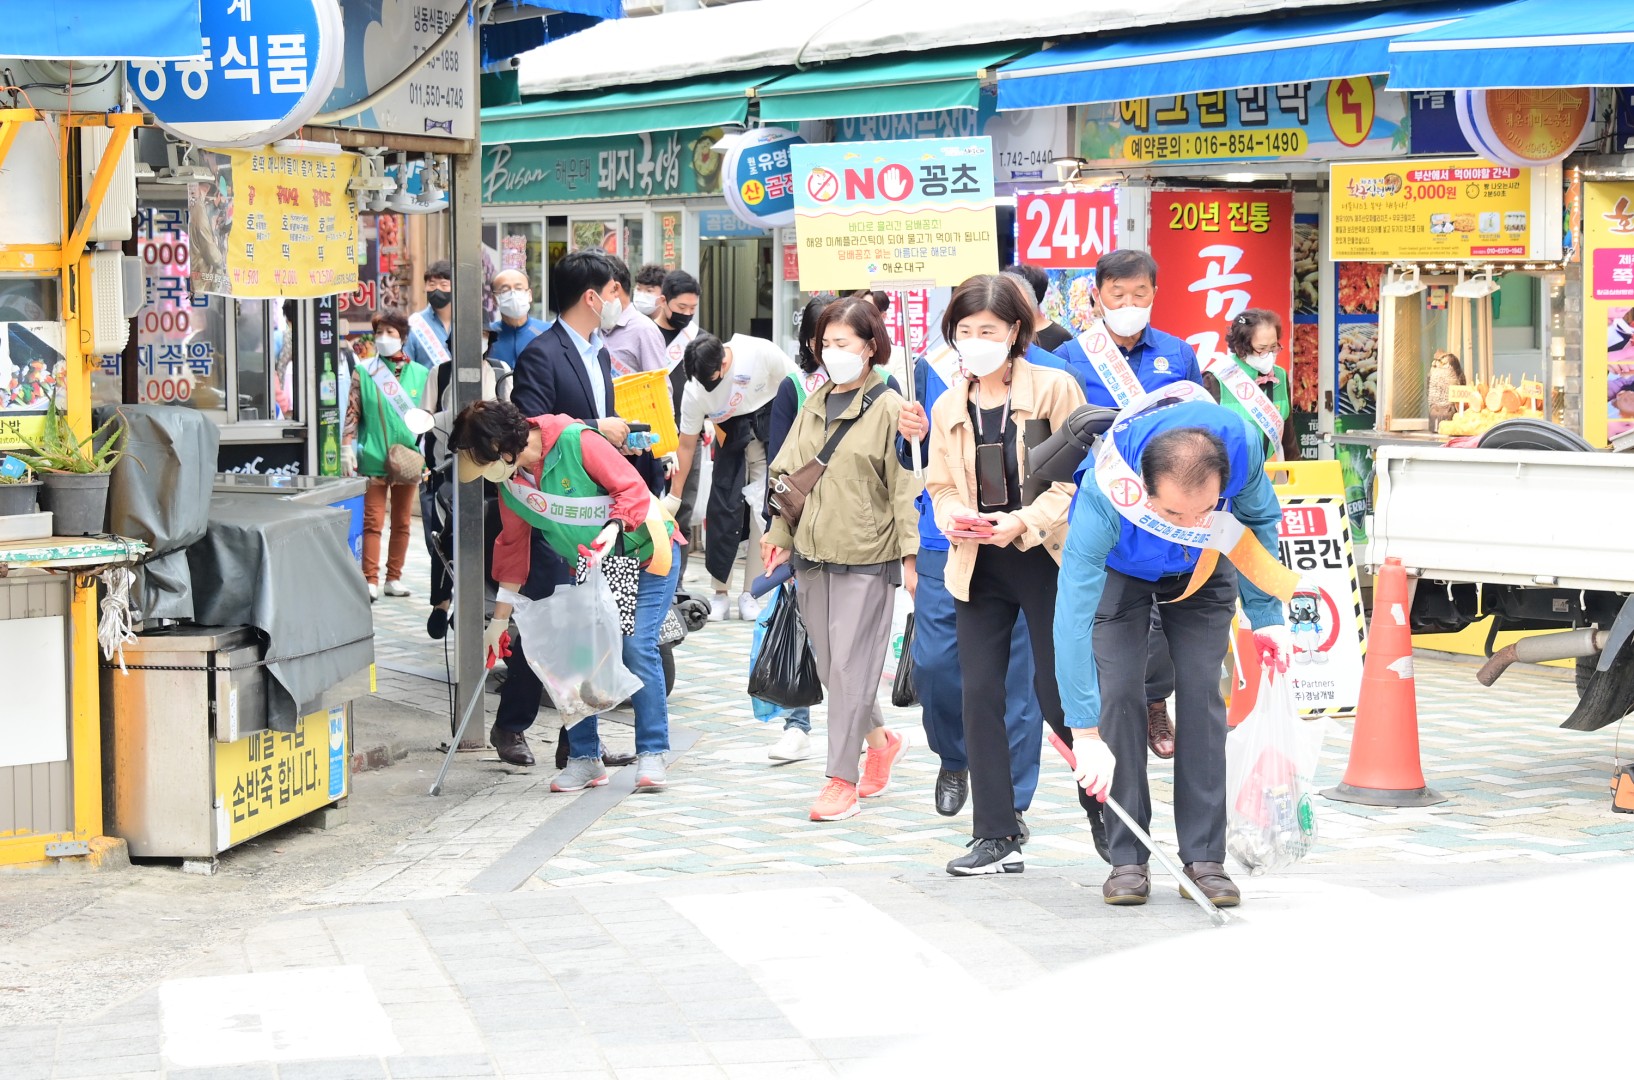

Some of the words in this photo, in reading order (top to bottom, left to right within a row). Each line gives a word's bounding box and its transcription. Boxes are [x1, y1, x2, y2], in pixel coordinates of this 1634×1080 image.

[1130, 136, 1182, 160] 예약문의
[1194, 131, 1300, 156] 016-854-1490
[252, 155, 265, 173] 호떡
[316, 161, 328, 178] 찾는
[758, 148, 791, 172] 유명
[1000, 150, 1053, 167] T.742-0440
[483, 144, 550, 202] Busan
[555, 157, 592, 190] 해운대
[919, 162, 981, 197] 꽁초
[1414, 169, 1449, 181] 부산에서
[1454, 168, 1490, 180] 먹어야할
[1493, 167, 1511, 179] 간식
[744, 182, 761, 201] 산
[1404, 184, 1457, 202] 3,000원
[1168, 201, 1221, 232] 20년
[1227, 201, 1271, 233] 전통
[848, 221, 874, 232] 바다로
[1026, 198, 1111, 260] 24시
[806, 237, 823, 248] 해양
[826, 234, 884, 247] 미세플라스틱이
[888, 234, 904, 245] 되어
[907, 233, 933, 245] 물고기
[936, 232, 961, 243] 먹이가
[964, 231, 990, 243] 됩니다
[838, 249, 872, 261] 담배꽁초
[894, 246, 928, 258] 아름다운
[931, 246, 957, 257] 해운대
[883, 262, 925, 273] 해운대구
[551, 502, 606, 519] 담배꽁초
[1301, 679, 1335, 689] Partners
[232, 764, 273, 824] 손반죽
[277, 747, 321, 805] 합니다.
